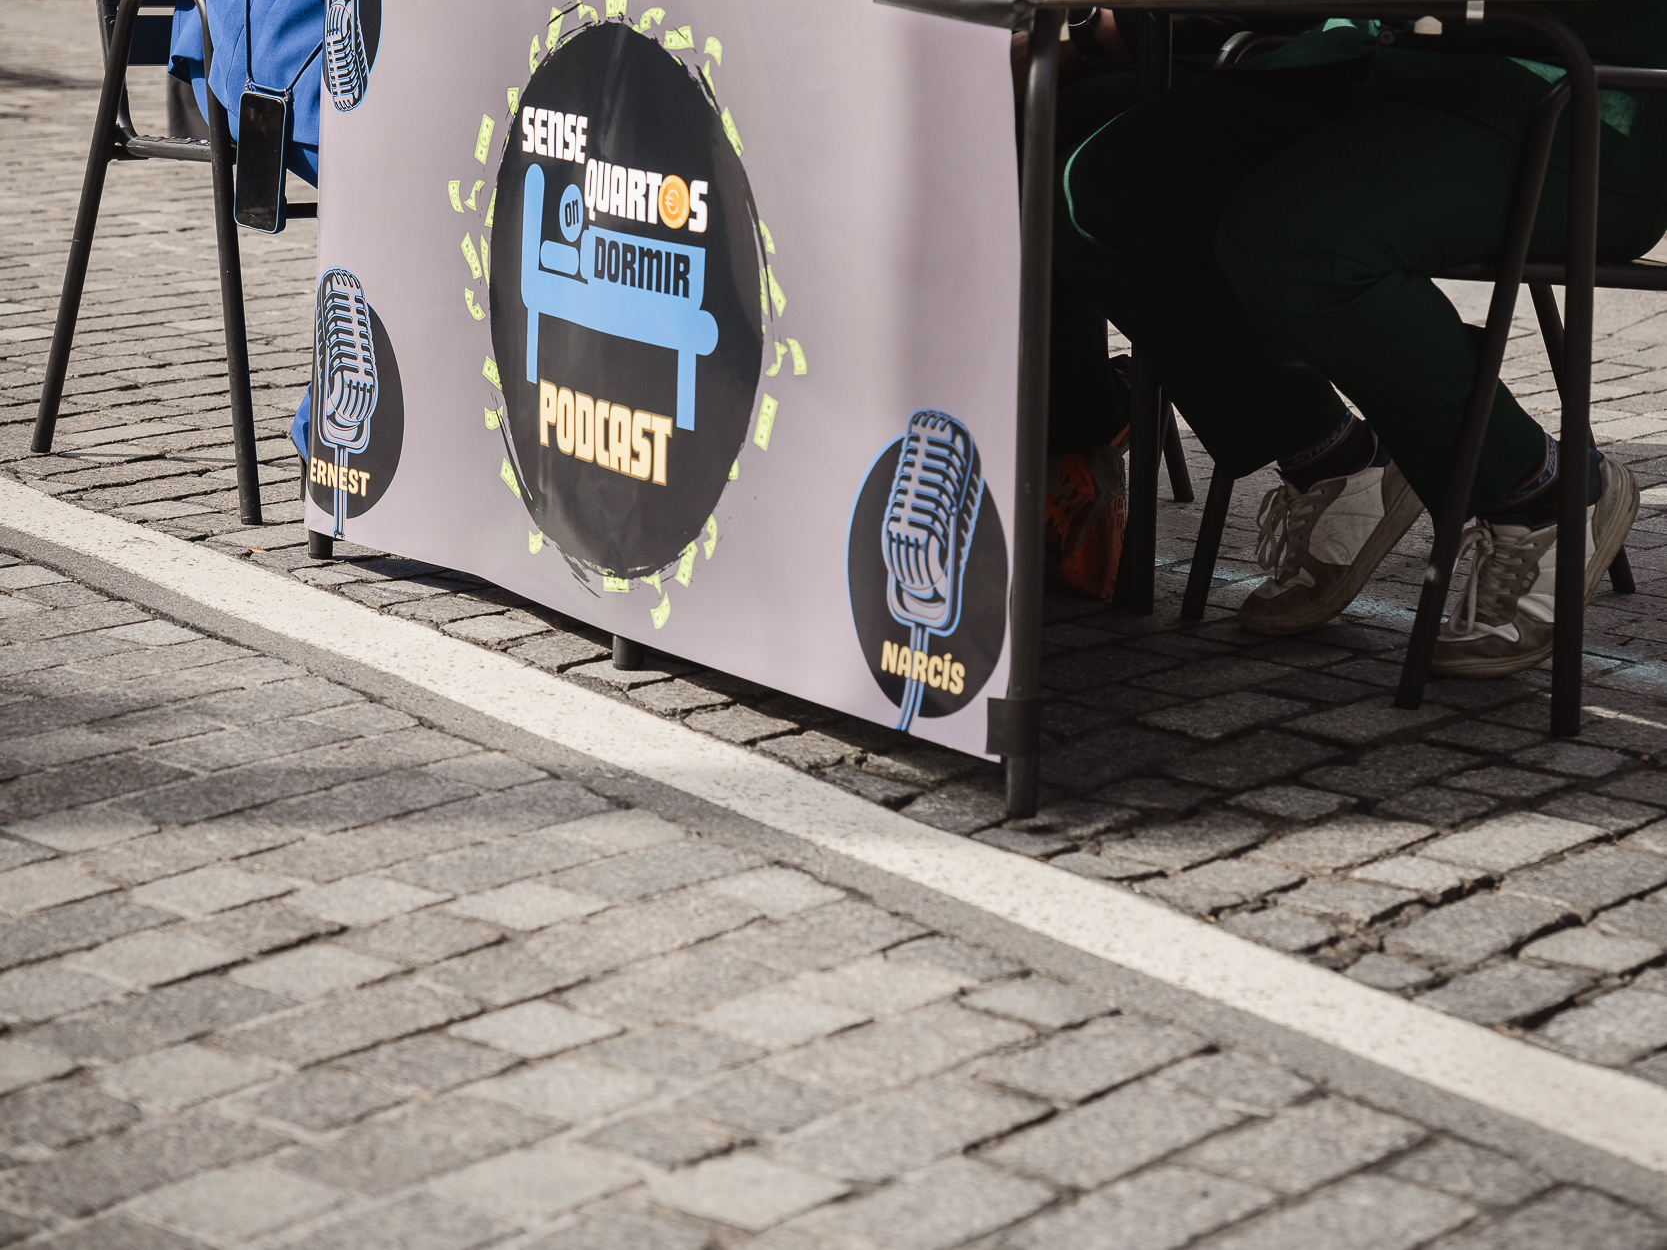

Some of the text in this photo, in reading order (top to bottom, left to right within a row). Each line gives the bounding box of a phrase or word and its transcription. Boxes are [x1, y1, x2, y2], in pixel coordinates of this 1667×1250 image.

[521, 106, 588, 164] SENSE
[594, 236, 690, 299] DORMIR
[539, 378, 673, 487] PODCAST
[309, 456, 371, 498] ERNEST
